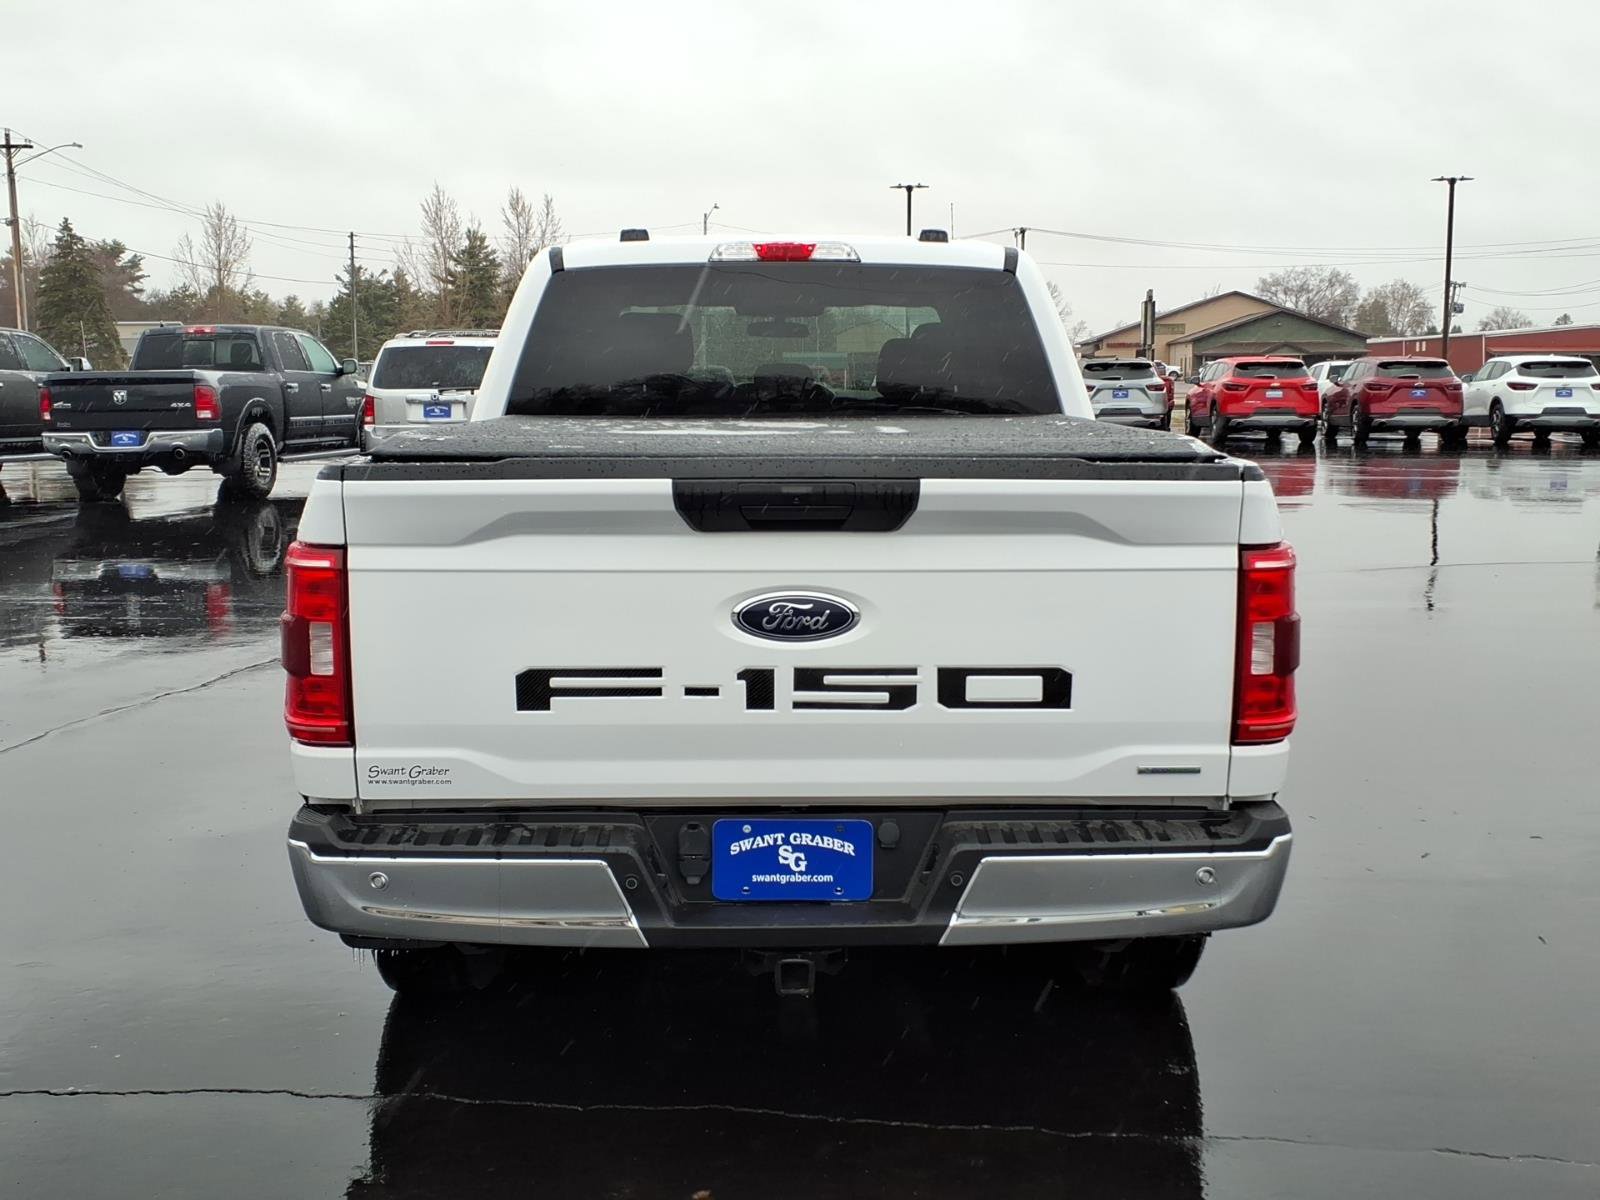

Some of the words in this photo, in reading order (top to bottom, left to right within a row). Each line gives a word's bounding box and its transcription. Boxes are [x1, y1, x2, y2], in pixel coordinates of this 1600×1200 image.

[762, 601, 830, 630] Ford
[515, 666, 1073, 711] F-150
[368, 765, 406, 779] Swant
[409, 765, 450, 779] Graber
[730, 832, 785, 855] SWANT
[789, 832, 856, 856] GRABER
[778, 845, 807, 872] SG
[752, 873, 833, 885] swantgraber.com
